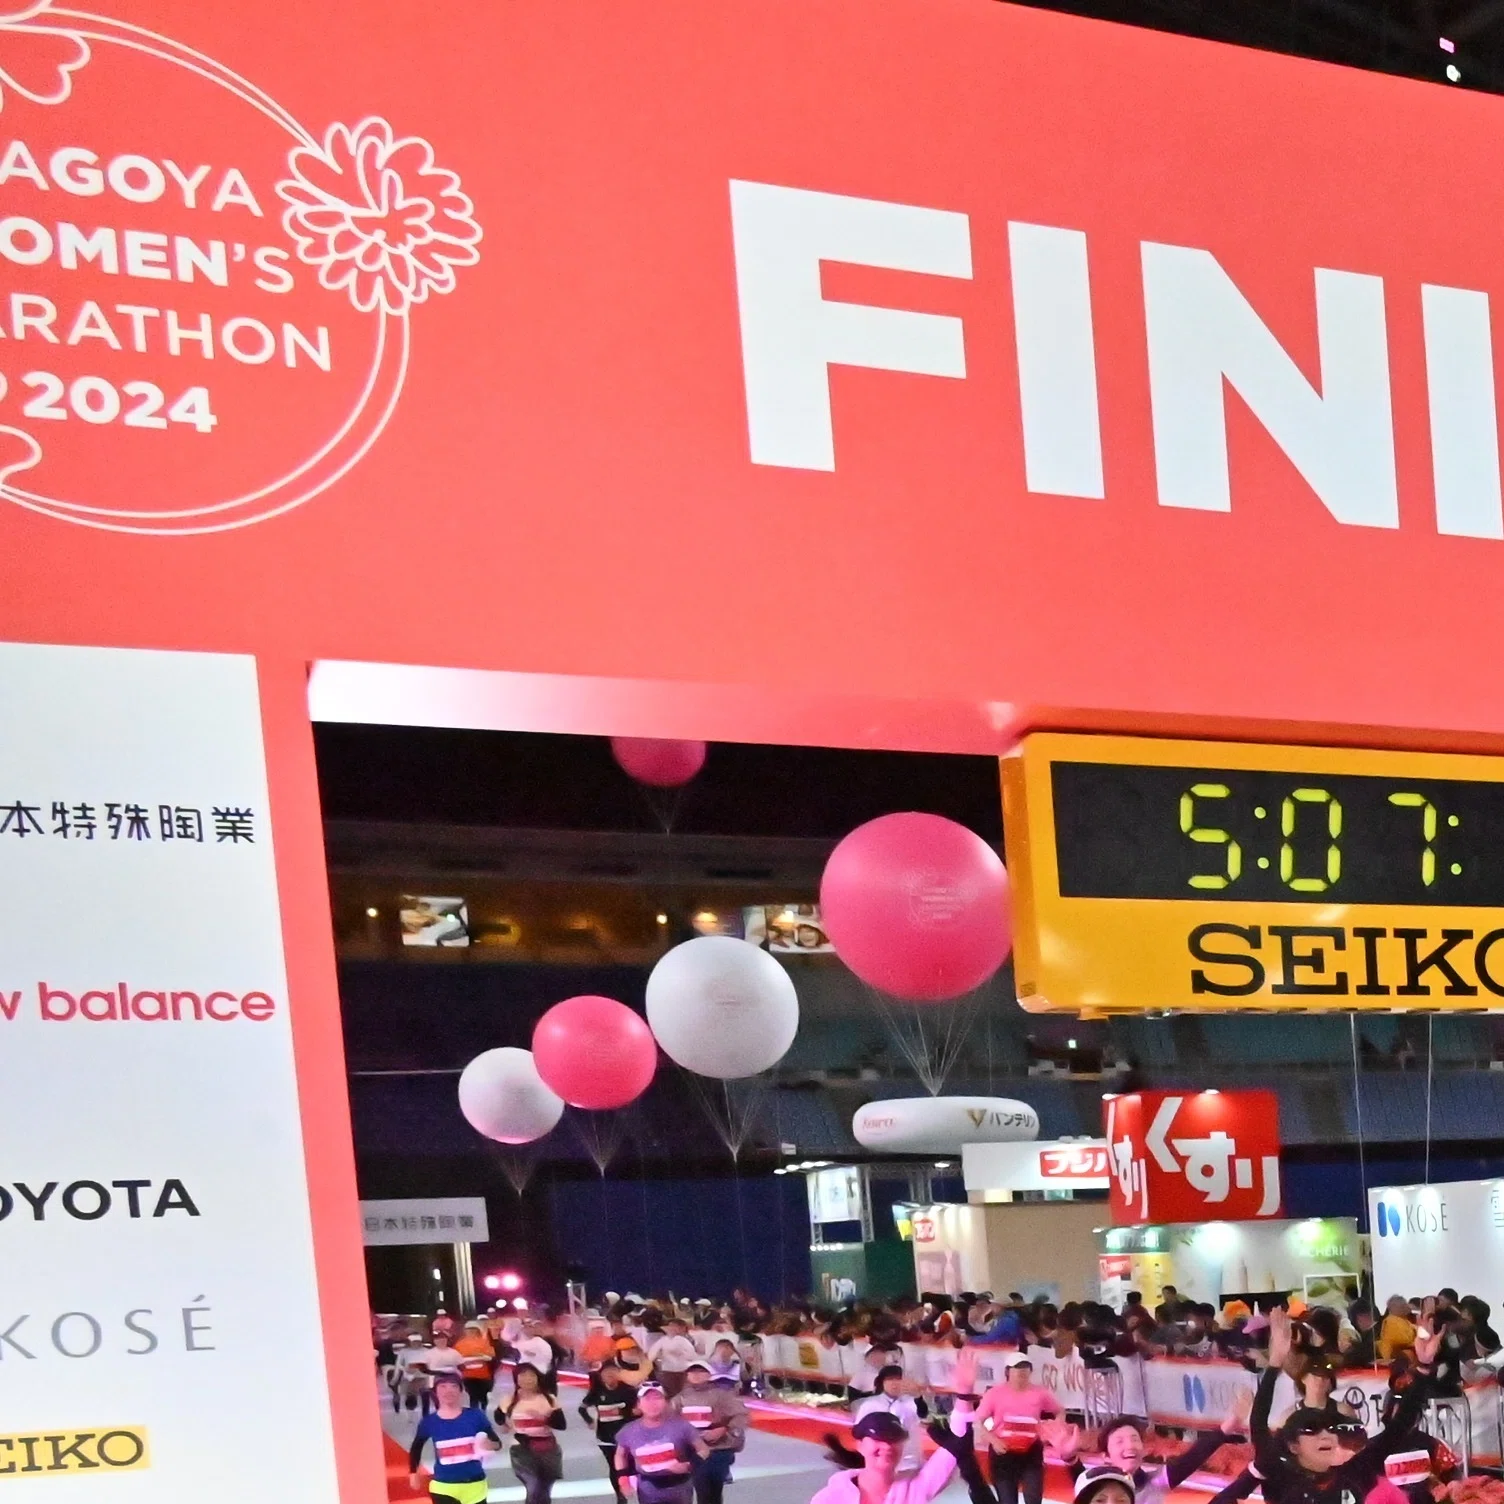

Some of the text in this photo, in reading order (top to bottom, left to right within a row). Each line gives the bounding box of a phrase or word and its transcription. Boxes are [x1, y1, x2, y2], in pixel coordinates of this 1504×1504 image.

[0, 293, 332, 372] RATHON
[22, 371, 218, 433] 2024
[38, 981, 276, 1022] balance
[1144, 1096, 1281, 1216] くすり
[0, 1178, 201, 1222] YOTA
